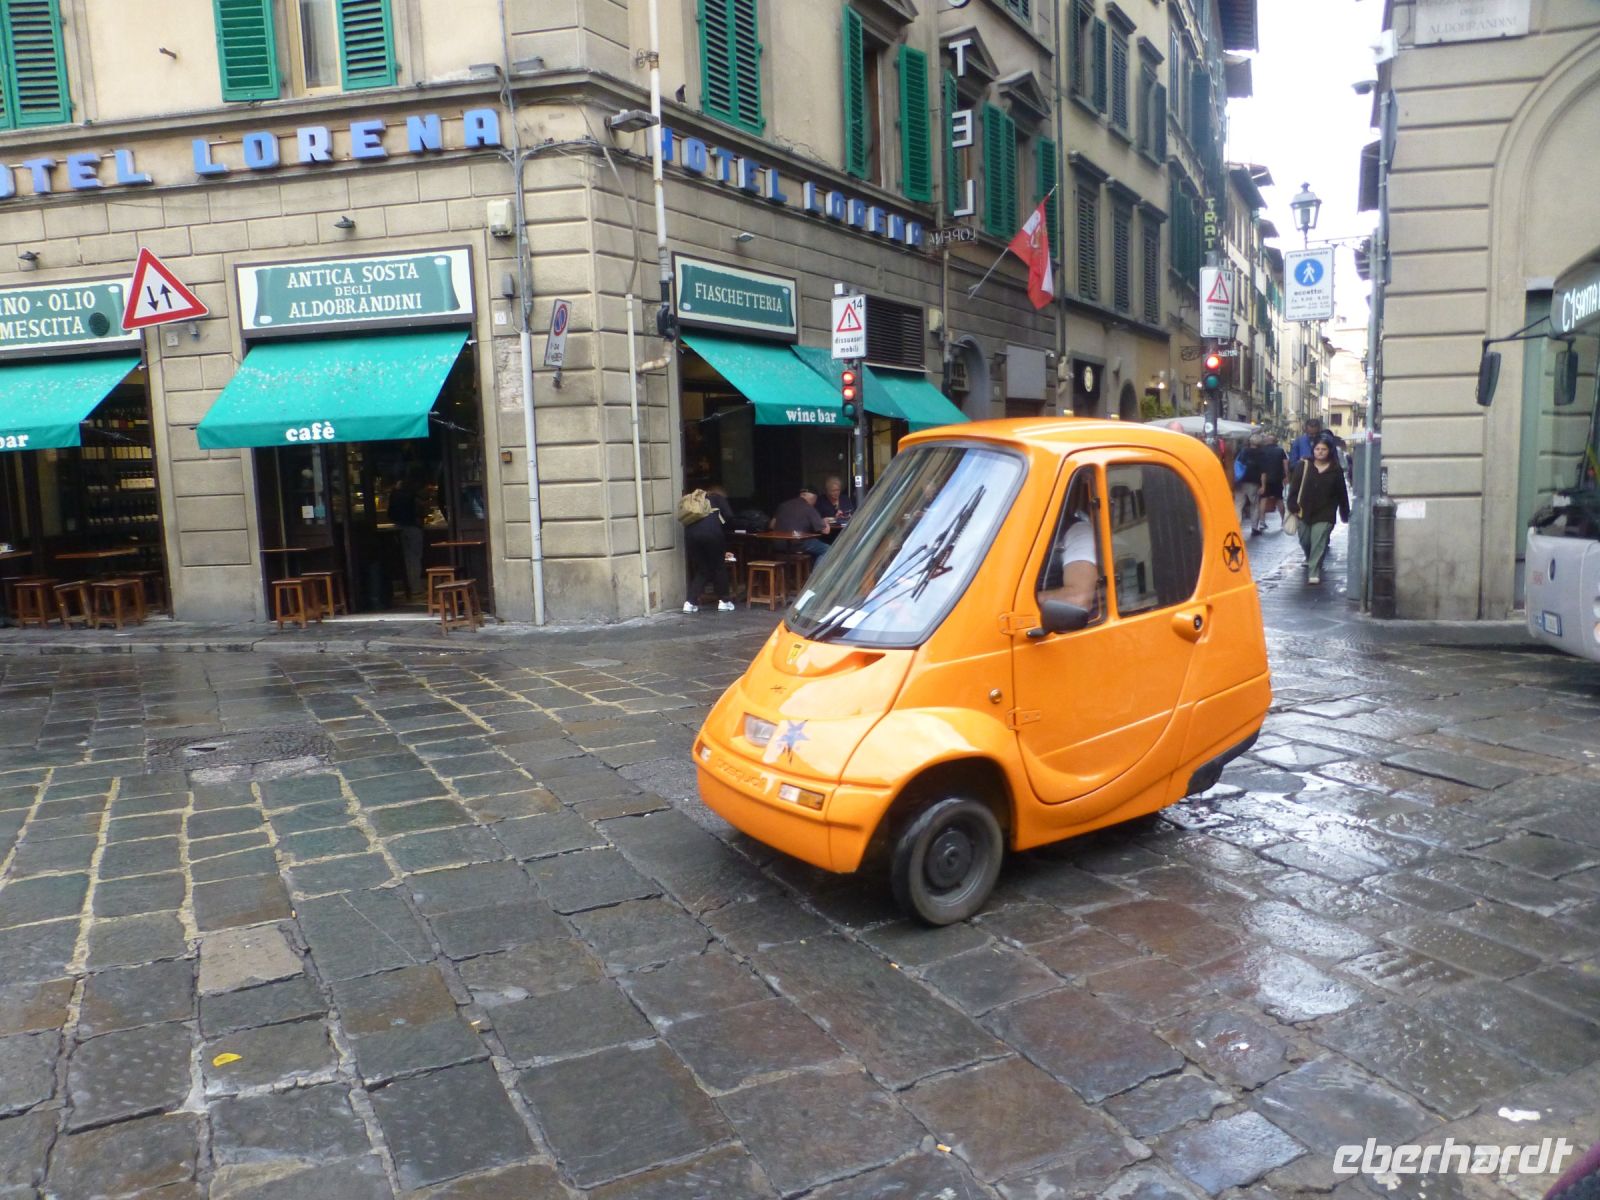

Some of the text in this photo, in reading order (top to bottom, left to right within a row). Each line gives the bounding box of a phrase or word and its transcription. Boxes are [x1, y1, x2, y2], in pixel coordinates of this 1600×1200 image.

[192, 108, 500, 176] LORENA
[287, 263, 419, 289] ANTICA SOSTA
[335, 284, 372, 297] DEGLI
[695, 282, 783, 314] FIASCHETTERIA
[48, 291, 96, 312] OLIO
[289, 293, 422, 319] ALDOBRANDINI
[852, 298, 863, 310] 14
[840, 345, 859, 353] mobili
[786, 407, 837, 423] wine bar
[285, 421, 335, 442] cafè
